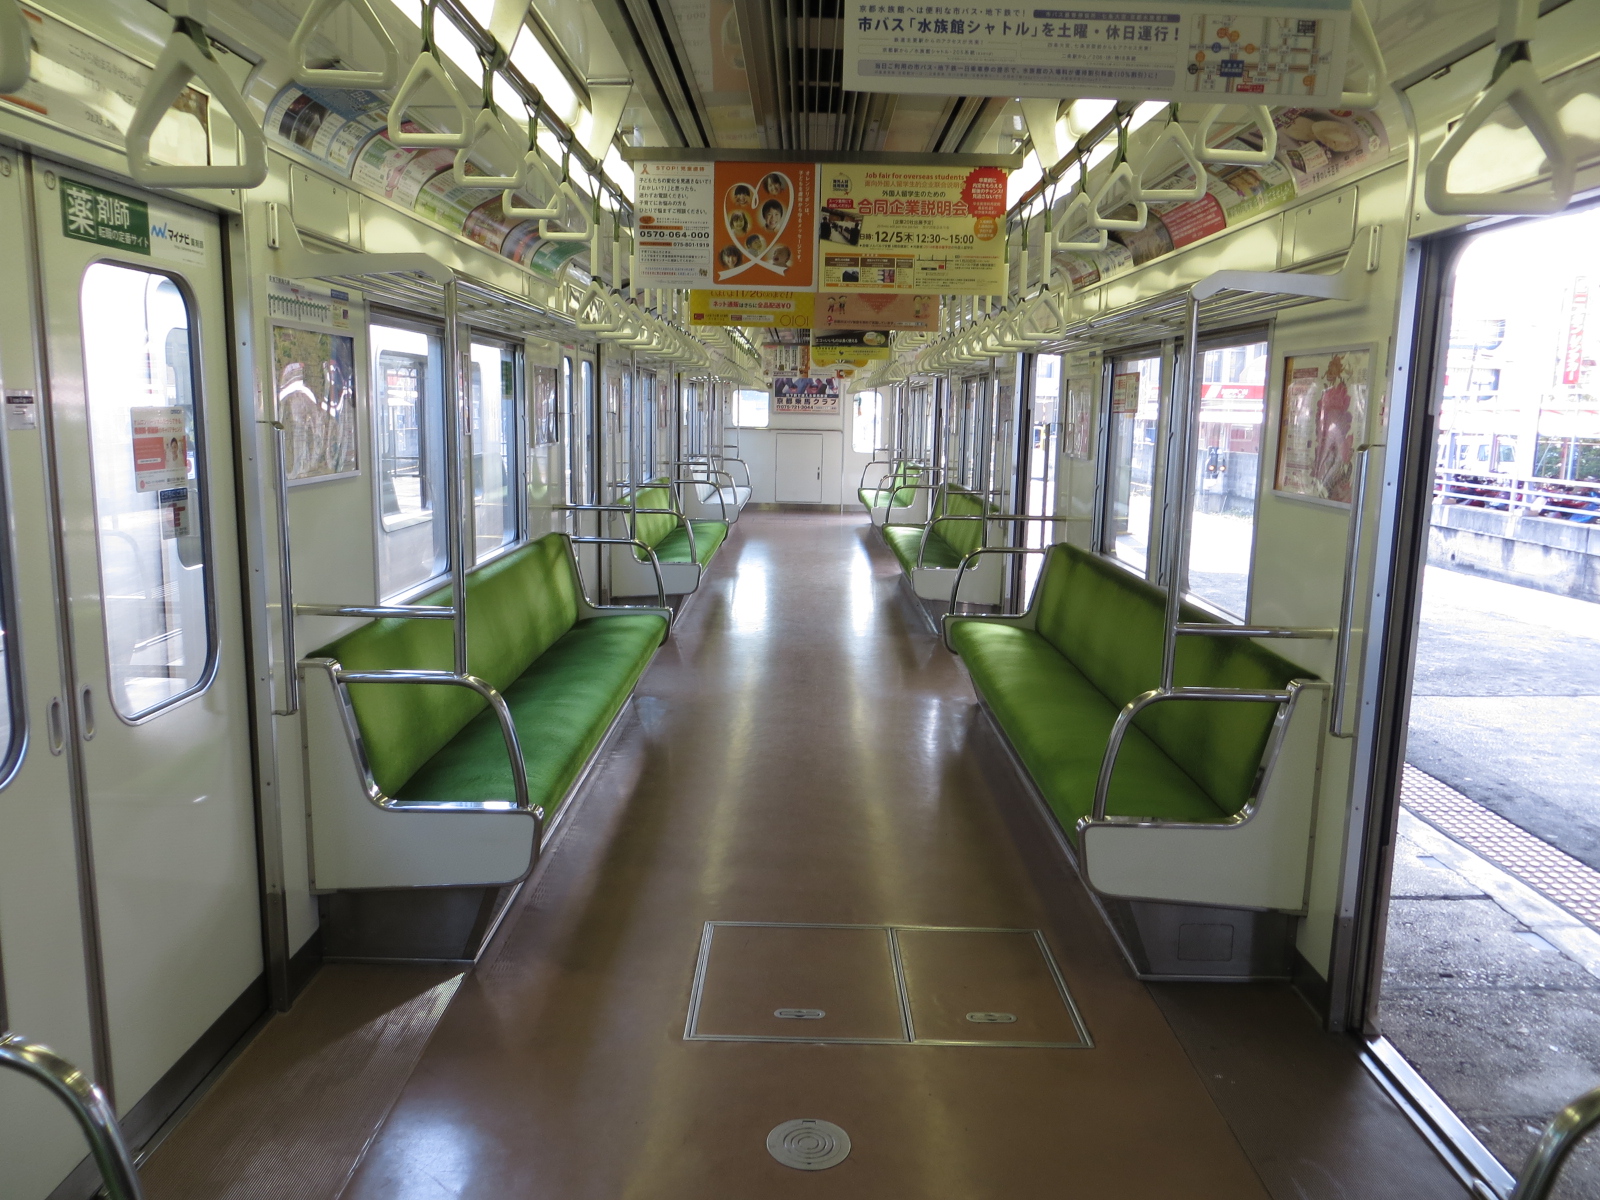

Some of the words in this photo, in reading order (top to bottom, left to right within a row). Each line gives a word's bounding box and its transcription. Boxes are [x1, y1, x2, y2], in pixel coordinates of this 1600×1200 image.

[858, 17, 1180, 42] 市バス「水族館シャトル」を土曜・休日運行！
[935, 173, 965, 181] students
[882, 190, 946, 198] 外国人留学生のための
[858, 199, 969, 217] 合同企業説明会
[98, 225, 149, 249] 転職の定番サイト
[167, 228, 190, 246] マイナビ
[640, 231, 710, 239] 0570-064-000
[875, 231, 903, 242] 12/5
[905, 233, 913, 242] 木
